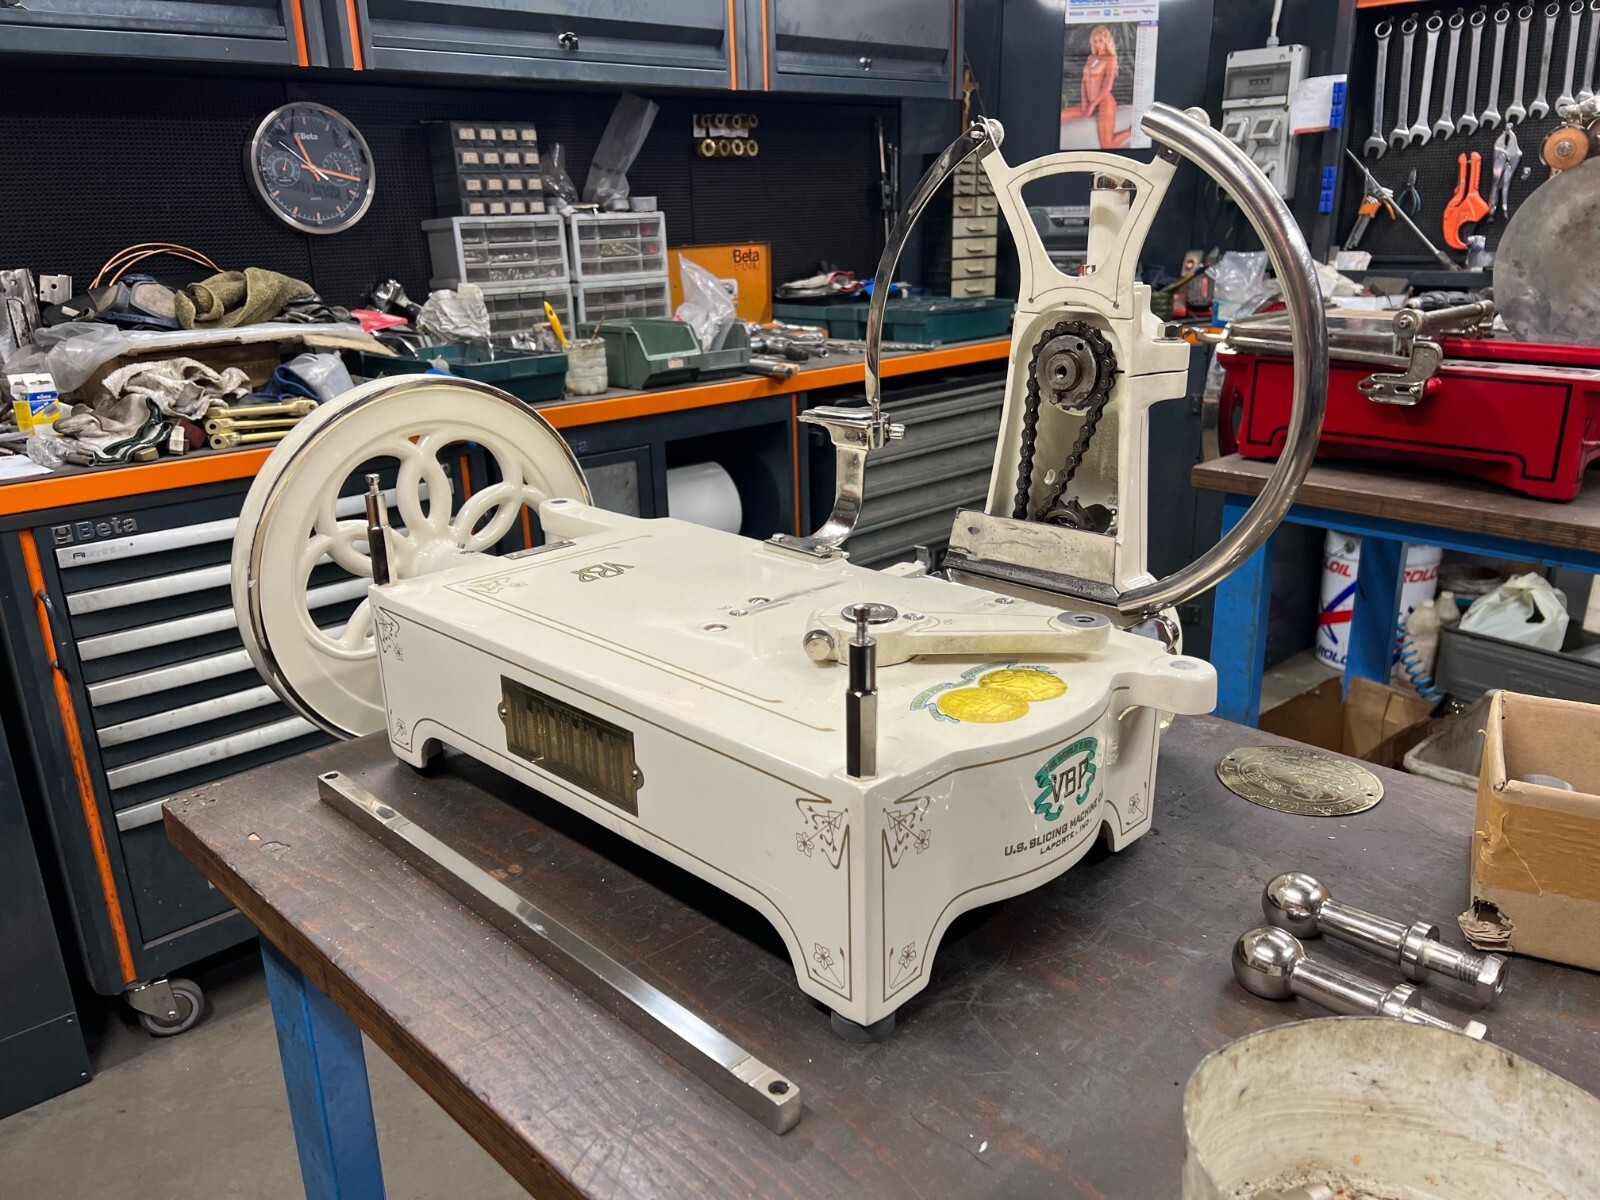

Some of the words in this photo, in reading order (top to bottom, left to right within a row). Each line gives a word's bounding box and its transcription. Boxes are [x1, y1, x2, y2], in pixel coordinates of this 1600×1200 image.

[300, 132, 319, 140] Beta
[733, 248, 760, 263] Beta
[75, 517, 139, 541] Beta
[1049, 757, 1089, 803] VBP
[1004, 841, 1028, 856] U.S.
[1029, 822, 1068, 849] SLICING
[1069, 797, 1098, 830] MACHINE
